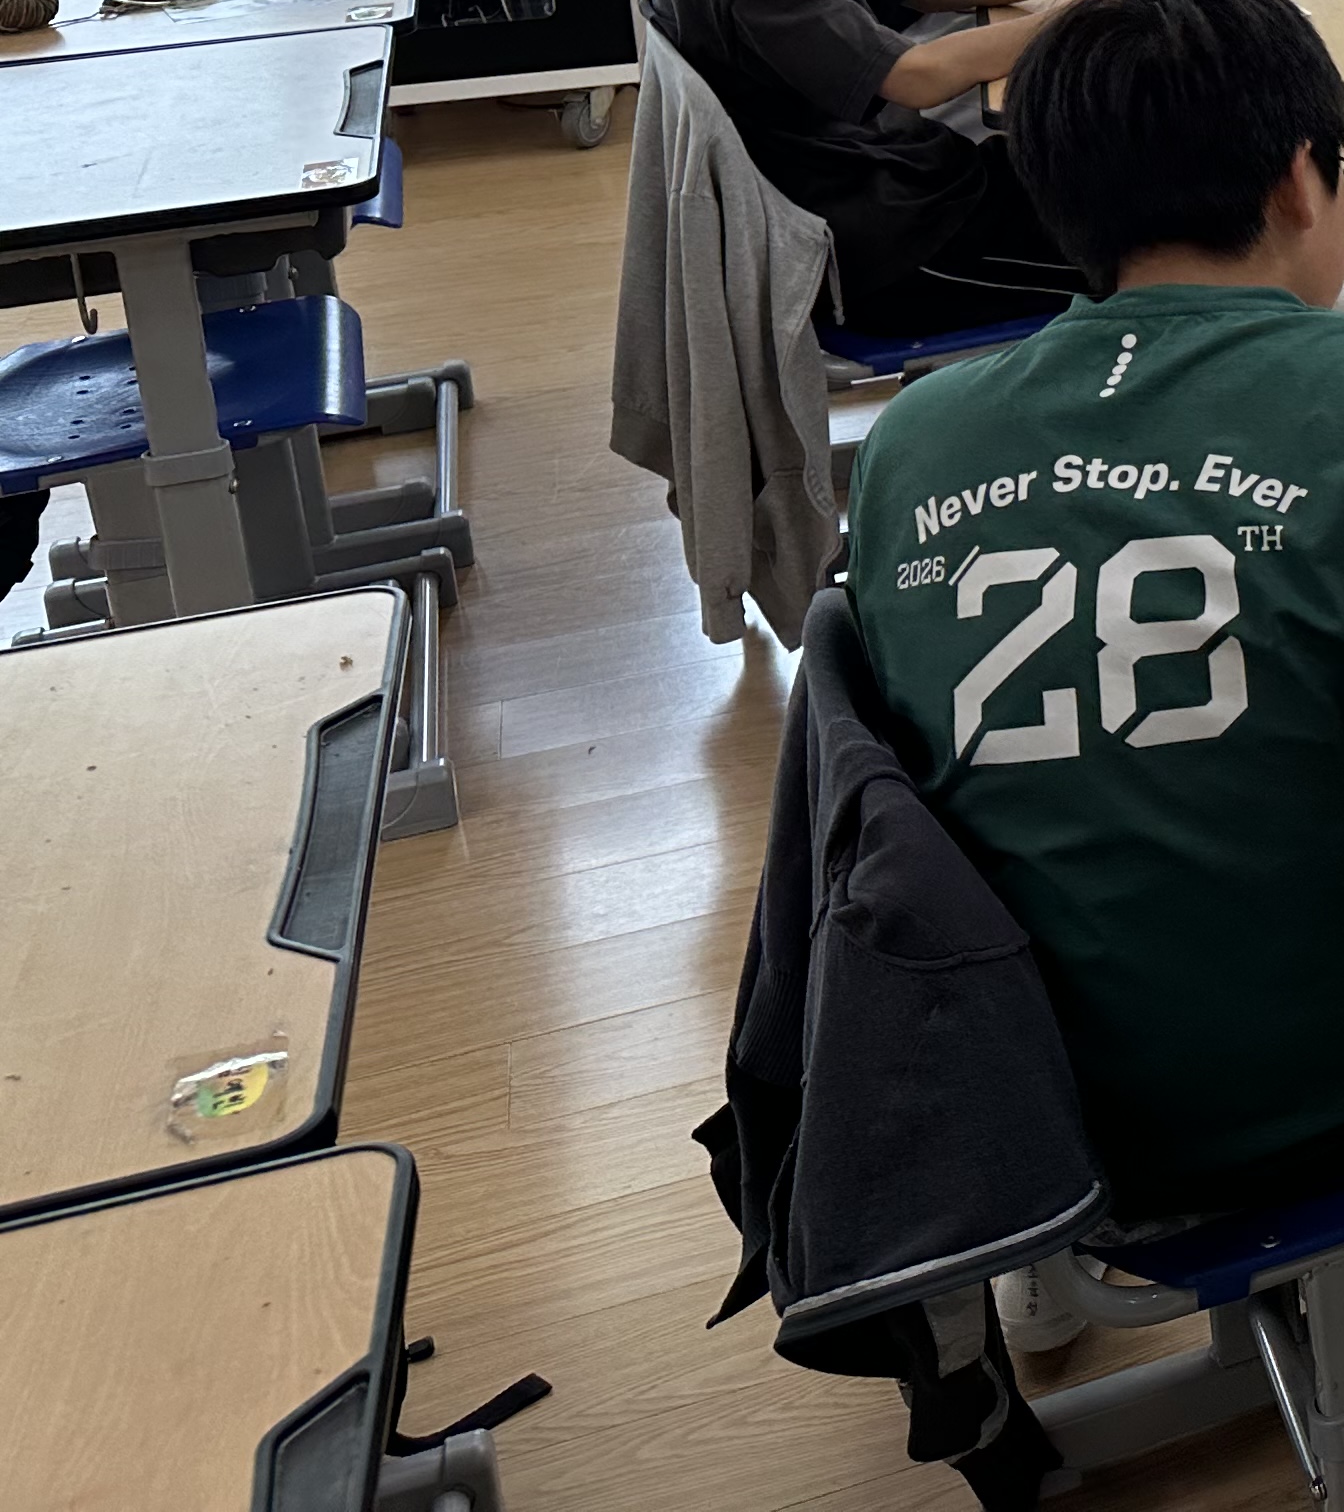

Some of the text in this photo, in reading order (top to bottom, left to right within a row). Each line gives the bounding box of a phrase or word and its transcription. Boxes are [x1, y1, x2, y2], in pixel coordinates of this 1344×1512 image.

[912, 453, 1309, 544] Never Stop. Ever
[1237, 525, 1283, 553] TH
[895, 533, 1250, 767] 2026 28
